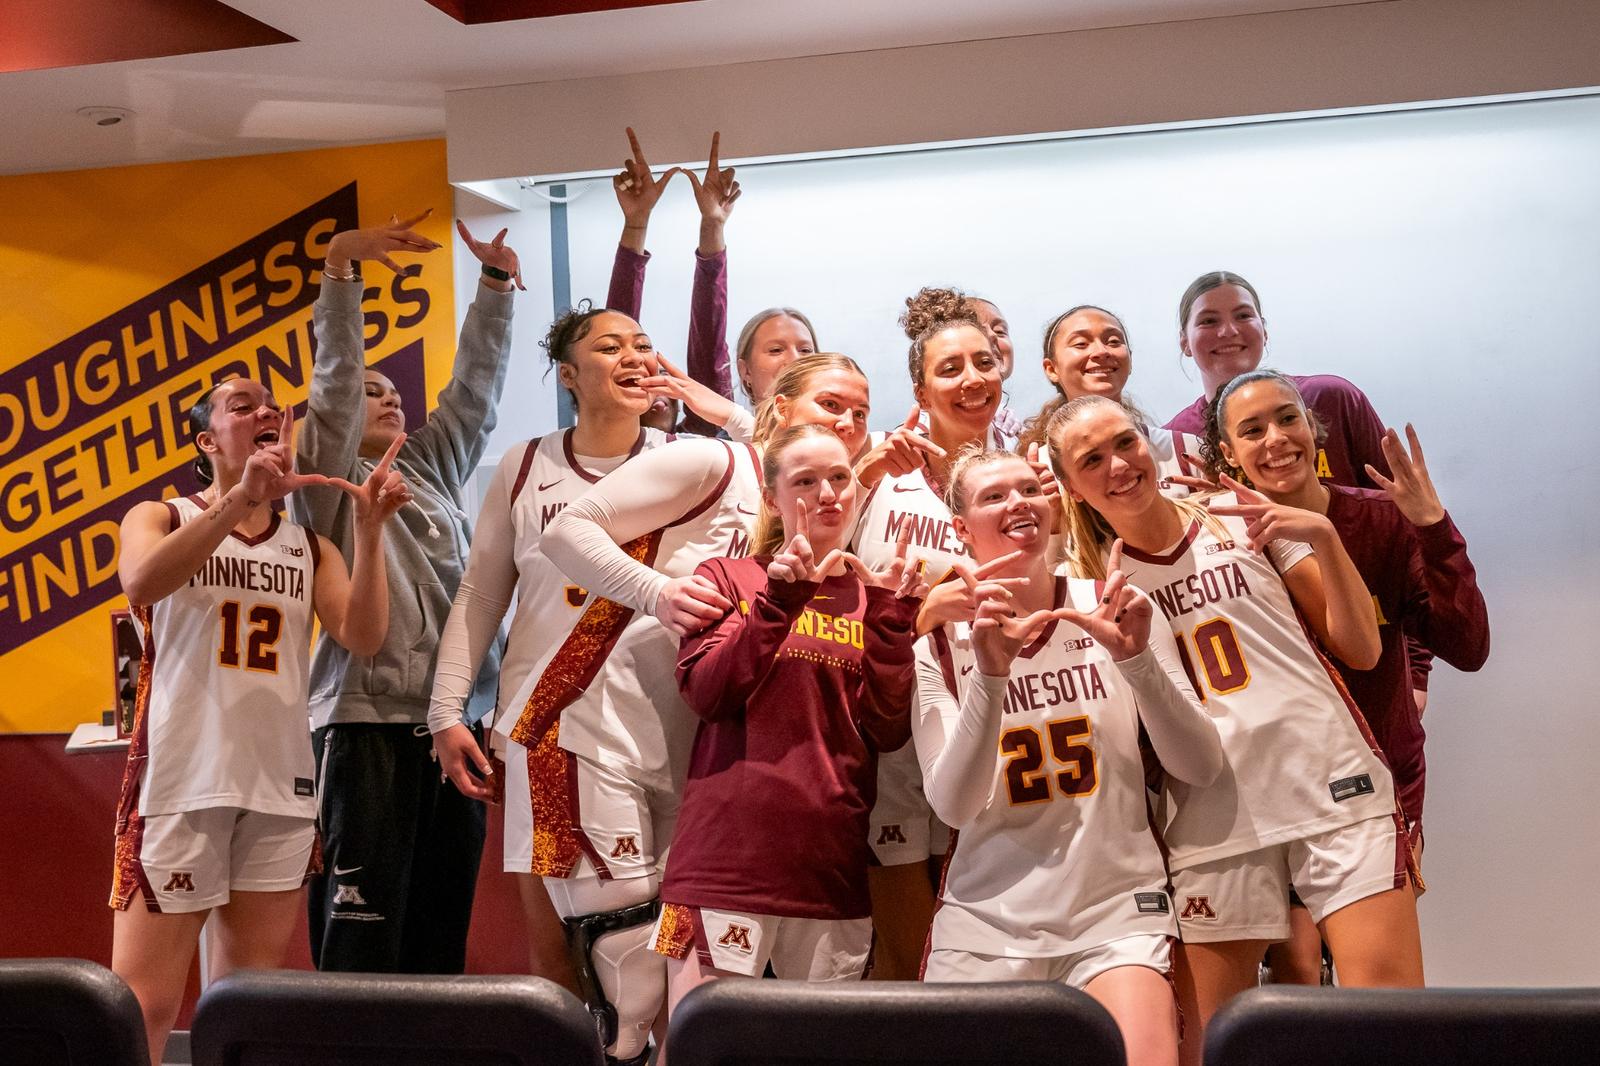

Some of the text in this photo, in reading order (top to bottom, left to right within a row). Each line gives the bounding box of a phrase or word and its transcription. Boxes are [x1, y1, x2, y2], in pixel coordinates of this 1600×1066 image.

[0, 264, 430, 534] GETHENSS
[884, 510, 967, 556] MNNES
[0, 520, 120, 623] IND
[218, 598, 284, 674] 12
[790, 610, 865, 650] NESO
[1000, 715, 1099, 807] 25
[610, 834, 641, 859] M
[876, 824, 907, 846] M
[162, 871, 196, 894] M
[1180, 894, 1217, 920] M
[716, 921, 753, 954] M
